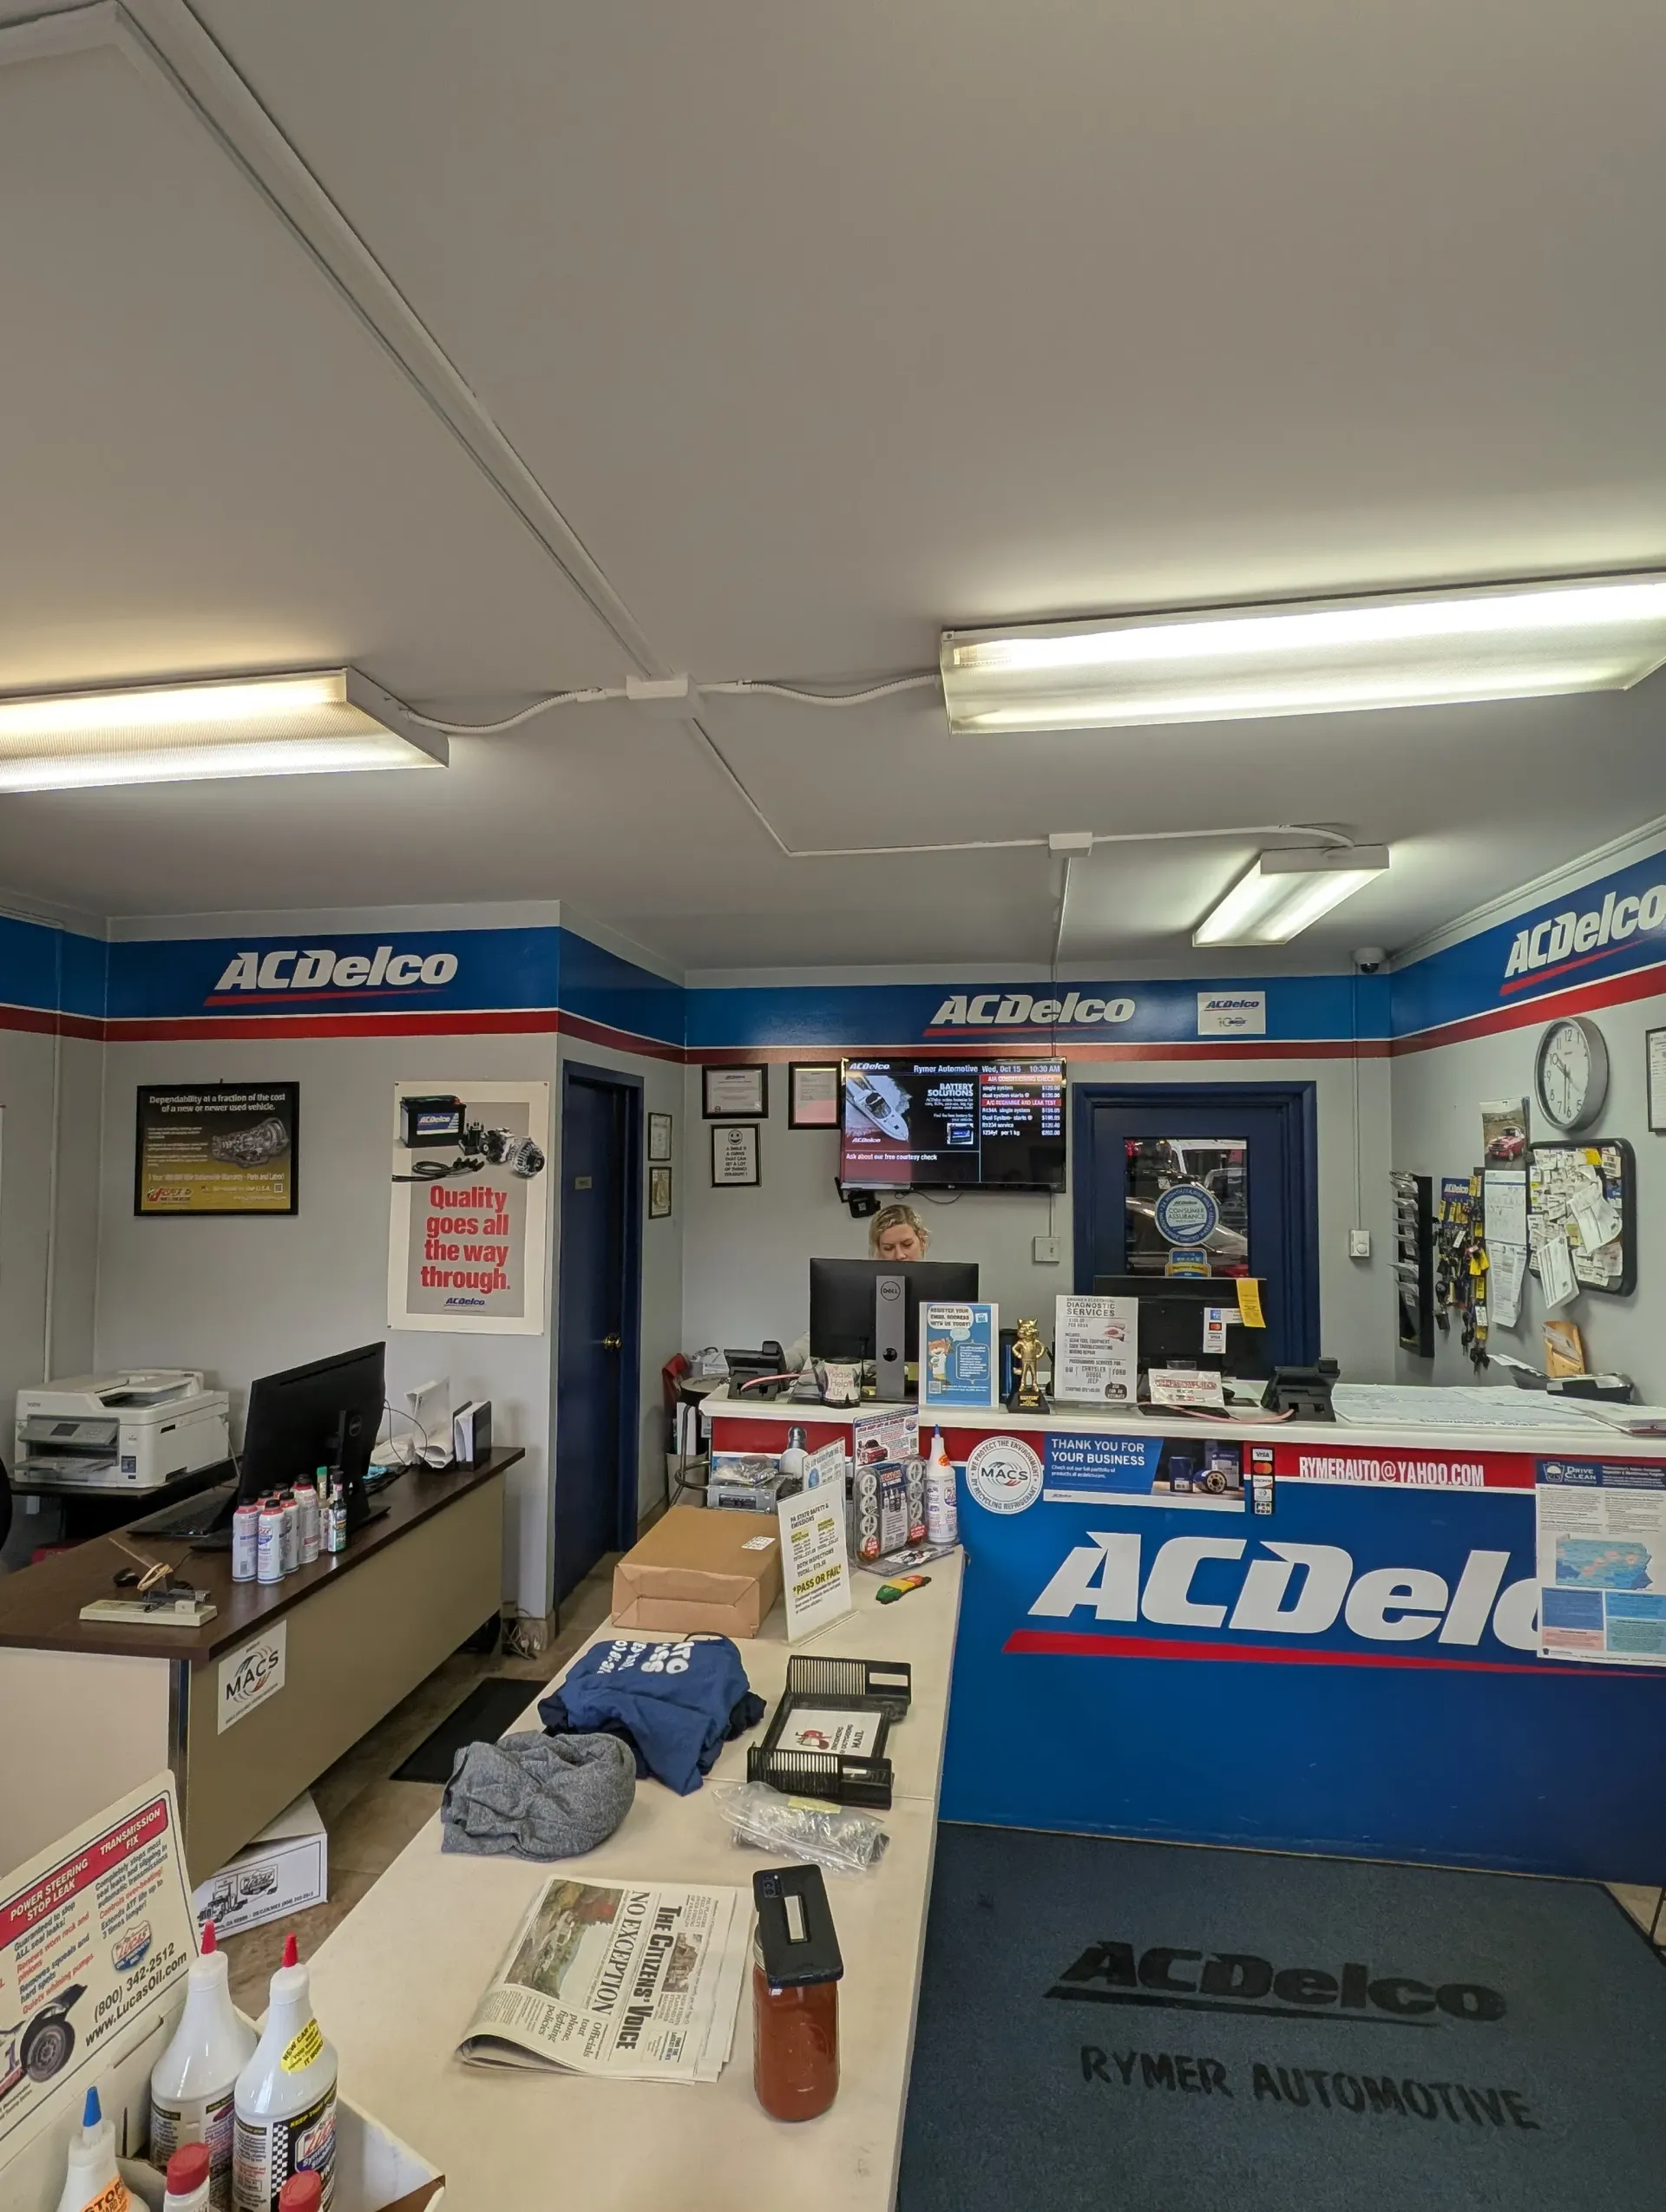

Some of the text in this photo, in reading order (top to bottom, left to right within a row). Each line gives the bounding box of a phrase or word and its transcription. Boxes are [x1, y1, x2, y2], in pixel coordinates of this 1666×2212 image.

[1504, 884, 1666, 978] ACDelco
[214, 946, 458, 990] ACDelco
[930, 992, 1136, 1024] ACDelco
[1205, 999, 1260, 1009] ACDelco
[1557, 1038, 1561, 1050] 11
[1564, 1030, 1572, 1041] 12
[914, 1065, 937, 1074] Rymer
[1550, 1053, 1558, 1065] 10
[1546, 1070, 1551, 1082] 9
[149, 1095, 201, 1104] Dependability
[218, 1094, 247, 1103] fraction
[270, 1093, 285, 1102] cost
[1549, 1089, 1555, 1101] 8
[1558, 1101, 1562, 1114] 7
[1577, 1100, 1582, 1113] 5
[418, 1116, 450, 1124] ACDelco
[1566, 1106, 1571, 1119] 6
[430, 1186, 508, 1214] Quality
[1444, 1183, 1468, 1194] ACDelco
[427, 1214, 508, 1238] goes all
[424, 1239, 508, 1266] the way
[421, 1266, 510, 1294] through.
[445, 1297, 485, 1306] ACDelco
[1066, 1308, 1115, 1317] SERVICES
[830, 1378, 849, 1389] Help
[974, 1442, 996, 1463] PROTECT
[1052, 1439, 1145, 1453] THANK YOU FOR
[1052, 1452, 1145, 1466] YOUR BUSINESS
[971, 1461, 978, 1471] WE
[1010, 1441, 1040, 1478] ENVIRONMENT
[1300, 1456, 1484, 1487] RYMERAUTO@YAHOO.COM
[981, 1468, 1028, 1481] MACS
[1564, 1471, 1596, 1480] CLEAN
[974, 1486, 1002, 1509] RECYCLING
[1003, 1485, 1037, 1509] REFRIGERANT
[810, 1505, 825, 1516] SAFETY
[815, 1573, 825, 1583] OR
[226, 1650, 279, 1700] MACS
[851, 1730, 864, 1749] MAIL
[100, 1808, 161, 1855] TRANSMISSION
[126, 1835, 140, 1849] FIX
[95, 1838, 161, 1891] Completely stops most
[96, 1850, 160, 1901] seal leaks and slipping
[10, 1858, 89, 1921] POWER STEERING
[97, 1853, 168, 1909] automatic transmissions
[27, 1879, 75, 1921] STOP LEAK
[99, 1895, 125, 1919] Controls
[101, 1884, 157, 1930] Extends ATF life up
[14, 1901, 76, 1952] Guaranteed to stop
[102, 1900, 148, 1940] 3 times longer!
[656, 1906, 682, 1932] THE
[15, 1918, 66, 1962] ALL seal leaks!
[16, 1911, 90, 1974] Renews worn rack and
[592, 1890, 651, 2015] NO EXCEPTION
[17, 1960, 43, 1985] pinions
[19, 1933, 90, 1994] Removes squeals and
[20, 1972, 56, 2004] hard spots
[23, 1953, 95, 2015] Quiets whining pumps
[94, 1942, 174, 2023] (800) 342-2512
[1059, 1941, 1506, 2021] ACDelco
[85, 1952, 187, 2047] www.LucasOil.com
[538, 2005, 555, 2037] policies
[548, 2009, 567, 2044] fighting
[561, 2014, 577, 2041] phone,
[578, 2019, 590, 2037] tout
[615, 2006, 654, 2051] VOICE
[582, 2021, 601, 2058] Officials
[1080, 2045, 1541, 2131] RYMER AUTOMOTIVE
[291, 2115, 304, 2128] KEEP
